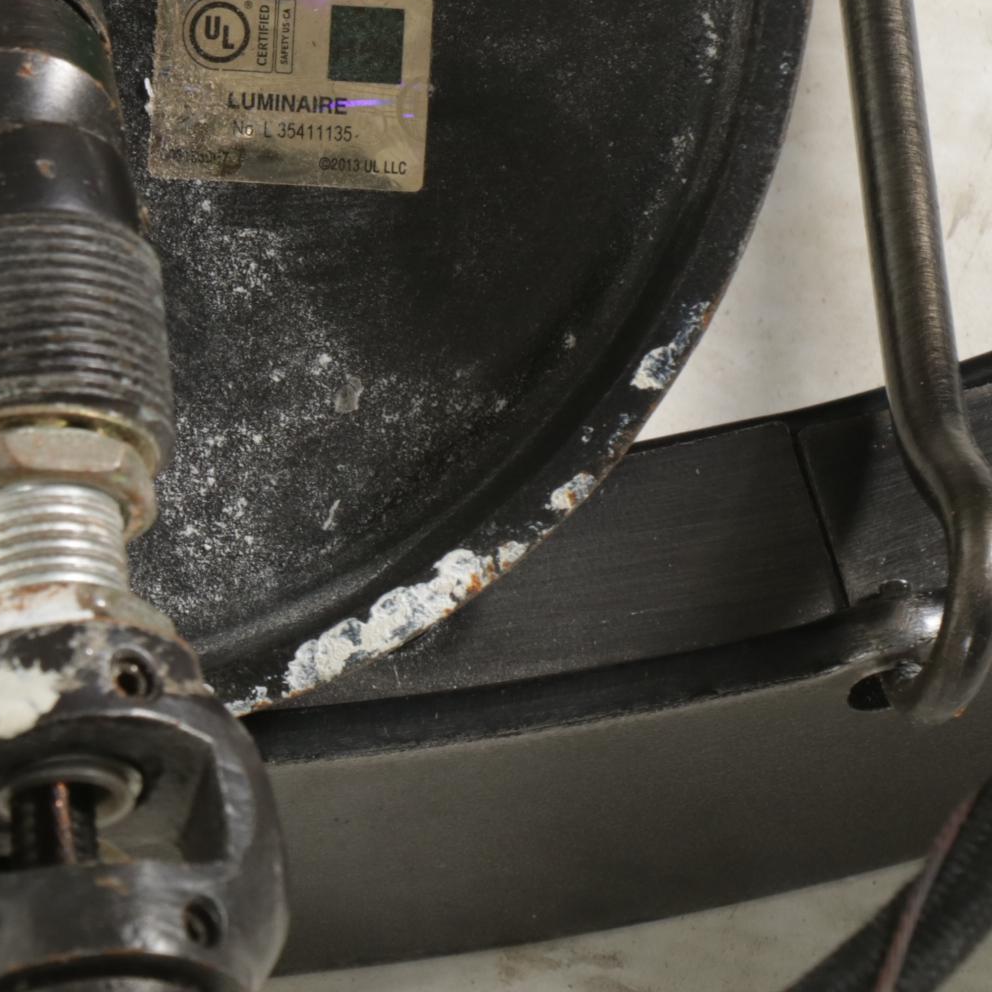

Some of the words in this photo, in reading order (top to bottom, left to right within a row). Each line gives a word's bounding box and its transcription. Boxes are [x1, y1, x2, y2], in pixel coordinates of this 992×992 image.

[205, 15, 235, 50] UL
[256, 4, 270, 66] CERTIFIED
[279, 34, 290, 65] SAFETY
[227, 91, 348, 115] LUMINAIRE
[278, 122, 352, 141] 35411135
[364, 160, 380, 173] UL
[384, 161, 407, 175] LLC
